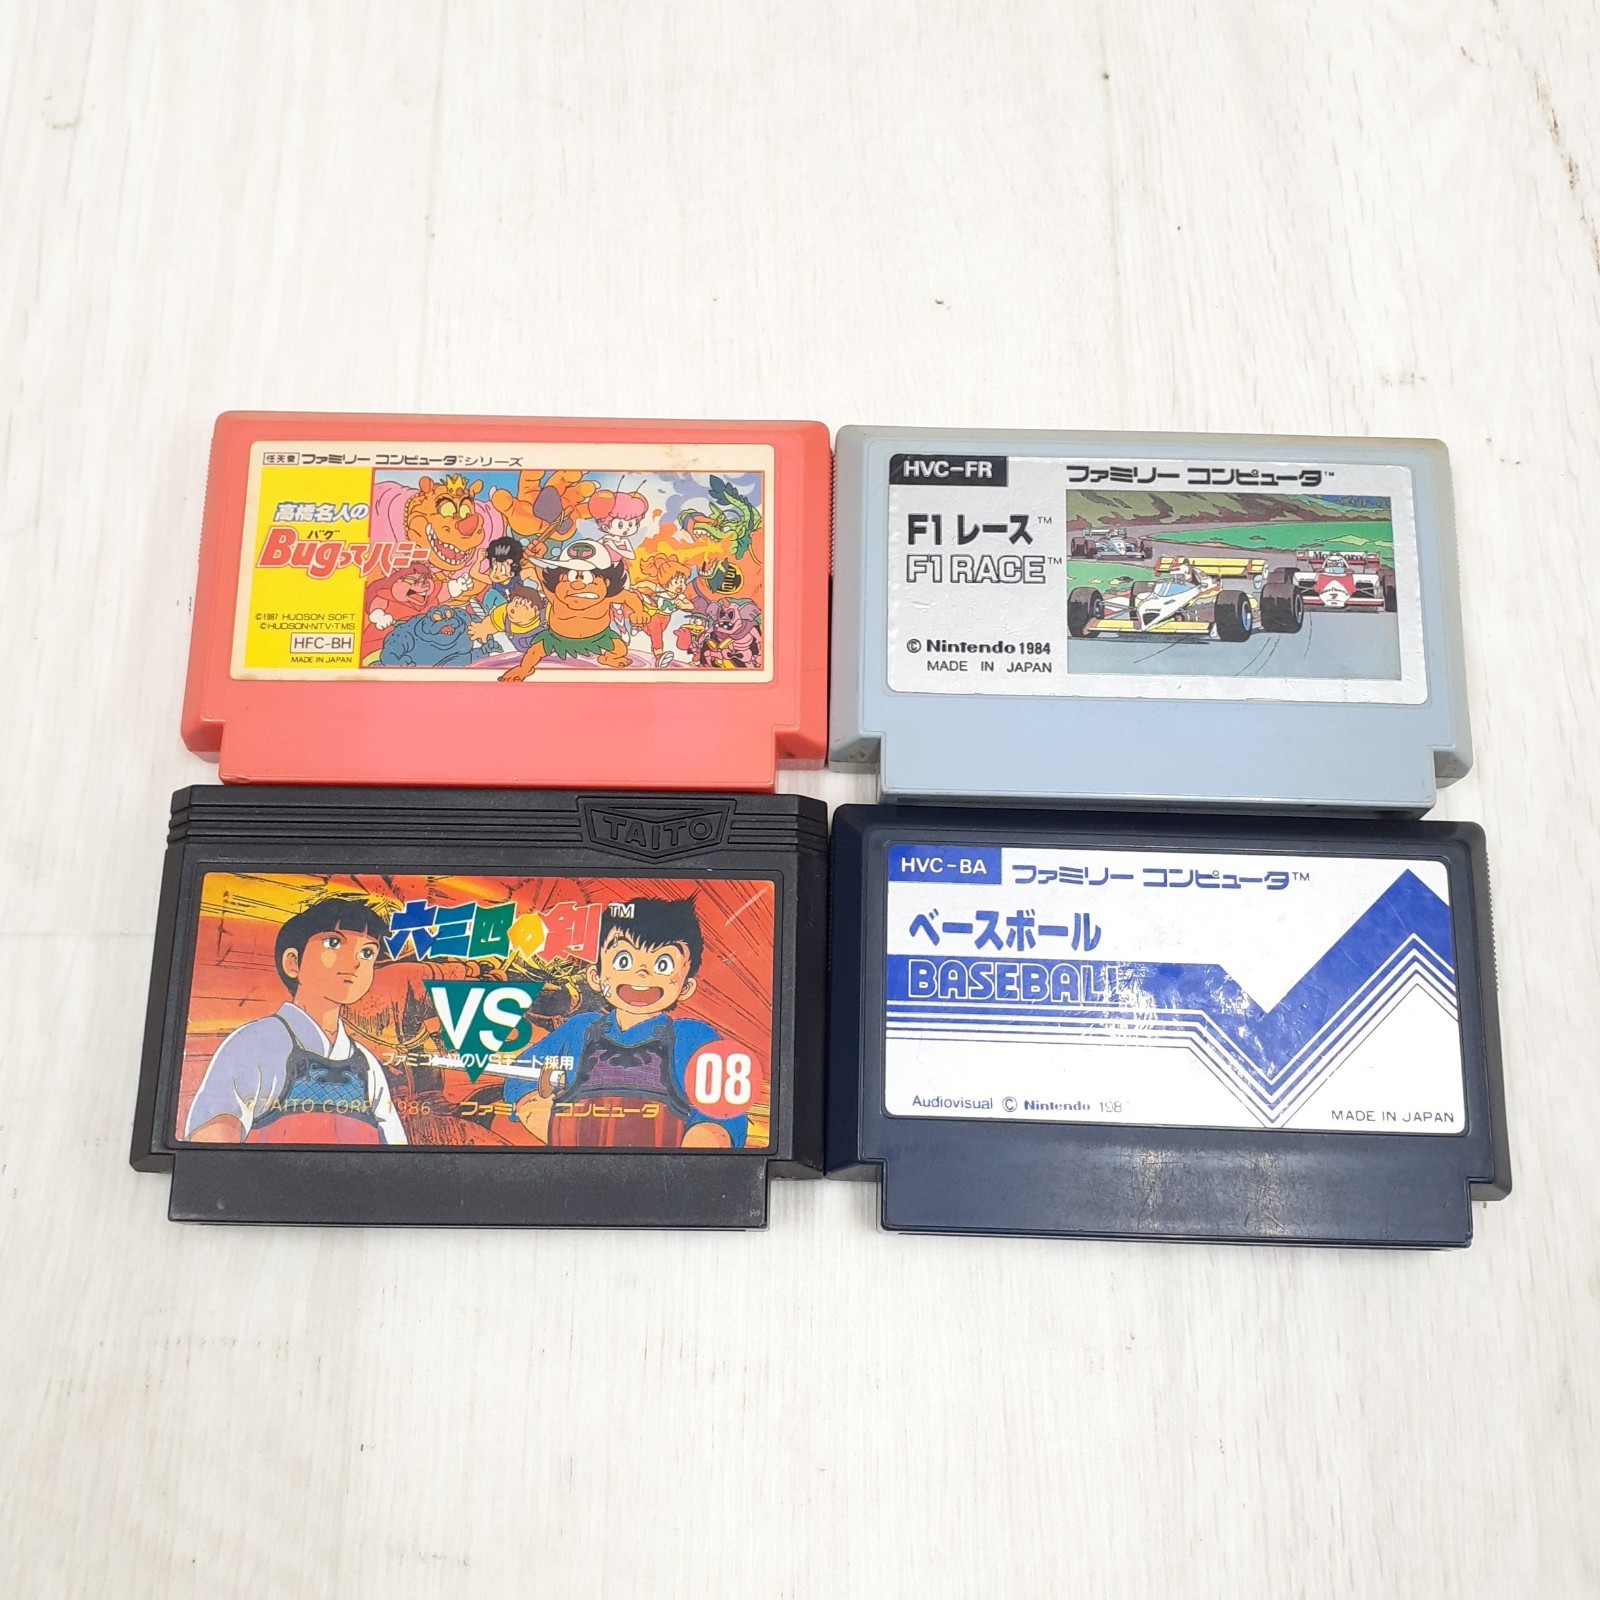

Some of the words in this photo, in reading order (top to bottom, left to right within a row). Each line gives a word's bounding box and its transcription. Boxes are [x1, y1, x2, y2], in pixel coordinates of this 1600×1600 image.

[302, 454, 371, 465] ファミリー
[465, 456, 524, 467] シリーズ
[903, 460, 993, 479] HVC-FR
[1066, 465, 1181, 483] ファミリー
[1187, 467, 1322, 487] コンピュータ
[273, 502, 370, 523] 高橋名人の
[307, 529, 341, 540] バグ
[908, 514, 942, 546] F1
[957, 514, 1034, 546] レース
[906, 554, 943, 583] F1
[950, 555, 1046, 584] RACE
[282, 613, 325, 621] HUDSON
[328, 613, 356, 621] SOFT
[293, 637, 352, 650] HFC-BH
[926, 639, 1016, 655] Nintendo
[1020, 642, 1051, 655] 1984
[291, 656, 313, 664] MADE
[316, 656, 324, 664] IN
[326, 656, 352, 664] JAPAN
[926, 660, 969, 672] MADE
[980, 661, 995, 672] IN
[1006, 661, 1053, 673] JAPAN
[602, 816, 714, 850] TAITO
[1012, 864, 1135, 886] ファミリー
[1142, 867, 1290, 891] コンピュータ
[908, 907, 1103, 953] ベースボール
[430, 986, 534, 1053] VS
[694, 1052, 753, 1105] 08
[387, 1101, 431, 1115] 1986
[554, 1102, 661, 1119] コンピュータ
[911, 1095, 994, 1111] Audiovisual
[1023, 1100, 1091, 1112] Nintendo
[1331, 1110, 1376, 1122] MADE
[1382, 1110, 1397, 1122] IN
[1402, 1111, 1455, 1123] JAPAN
